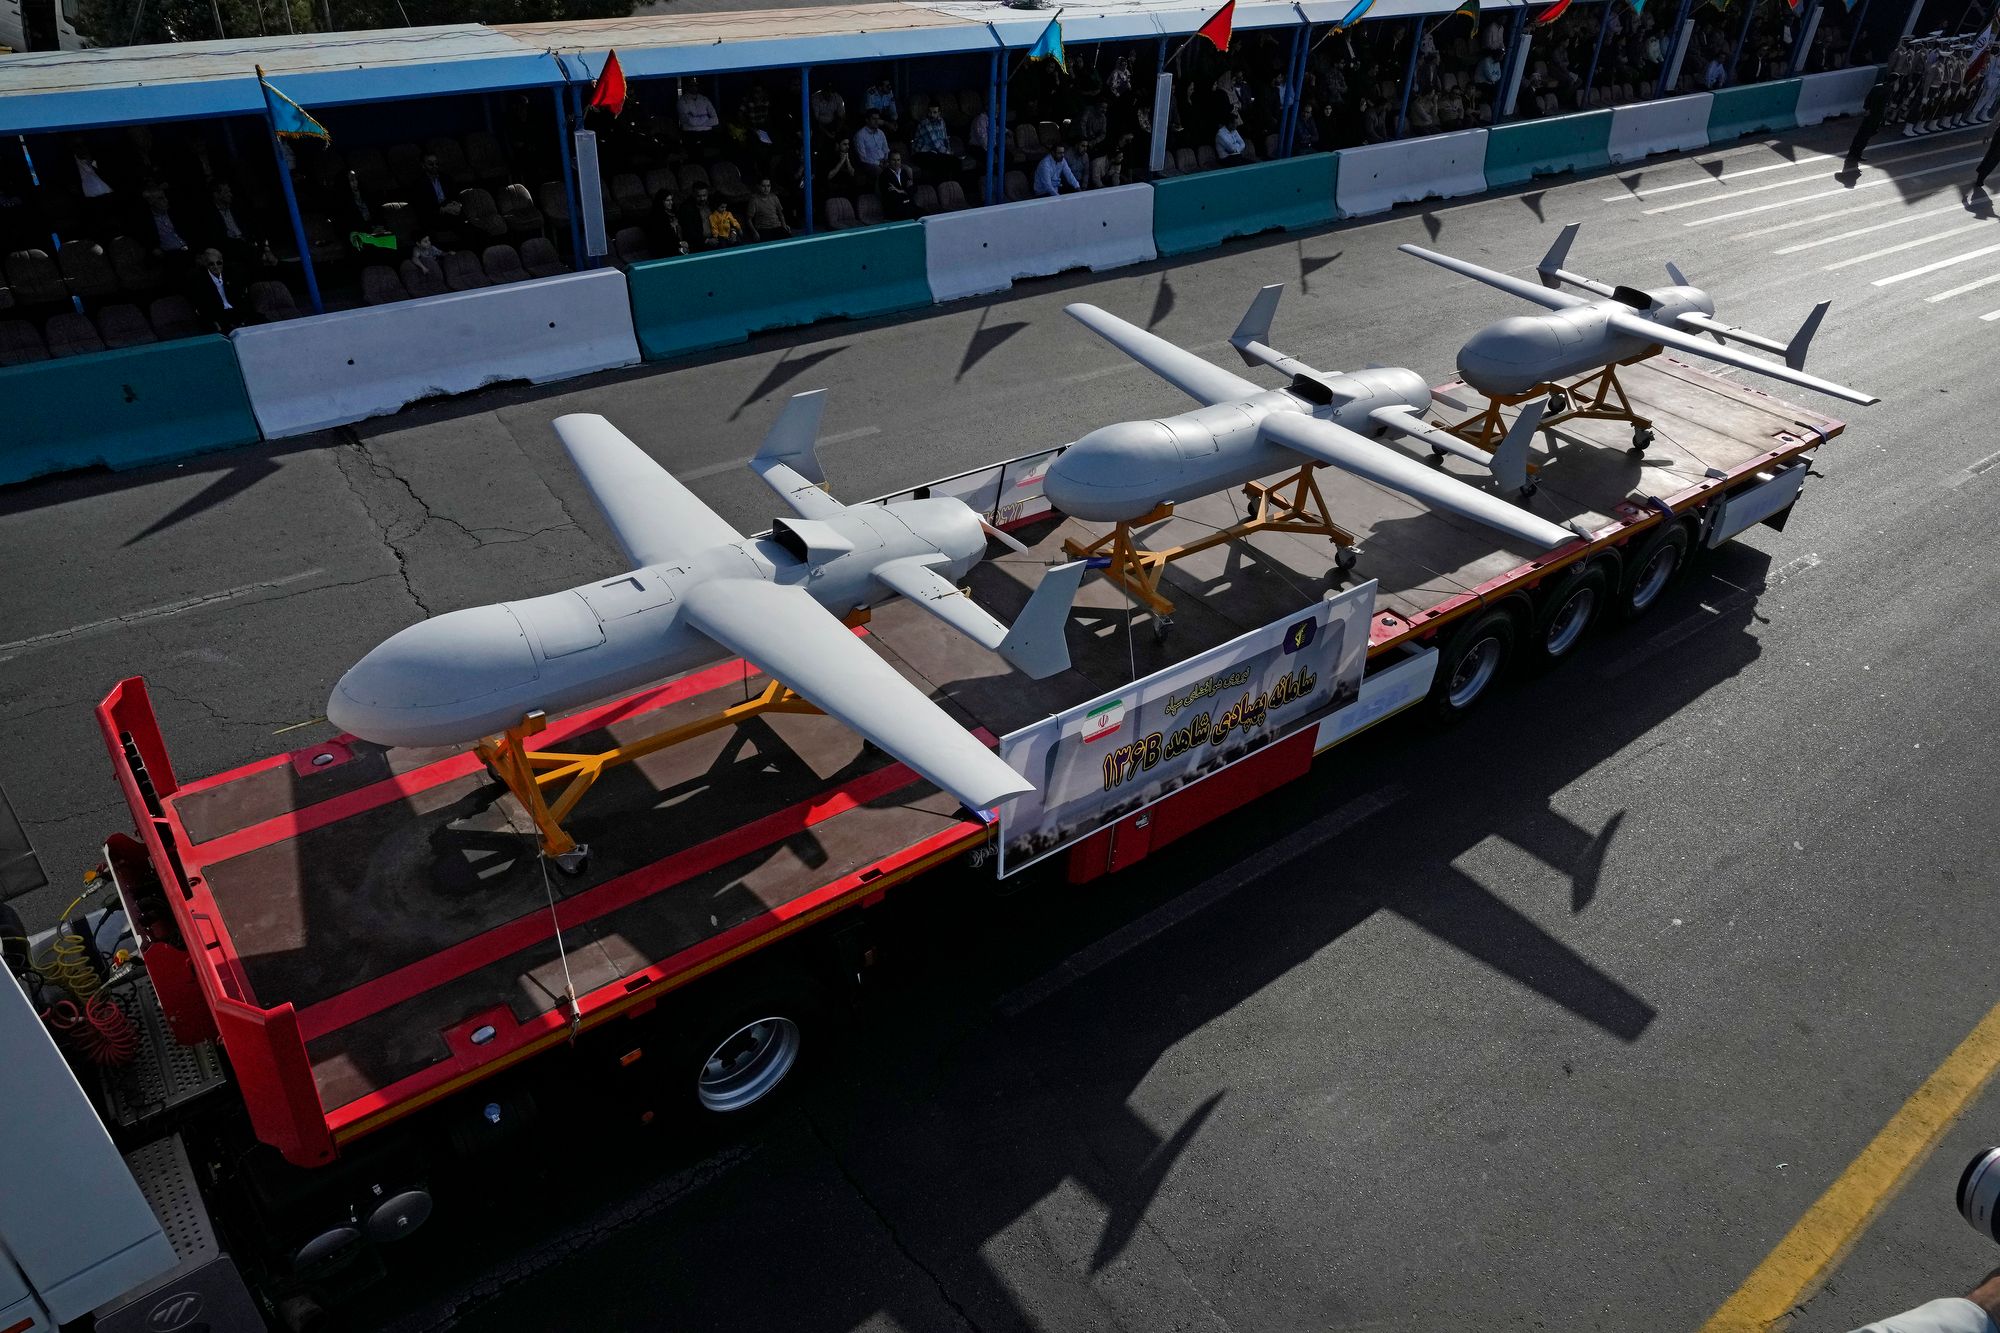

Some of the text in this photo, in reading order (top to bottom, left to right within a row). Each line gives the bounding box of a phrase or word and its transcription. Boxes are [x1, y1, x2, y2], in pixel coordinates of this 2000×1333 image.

[1268, 664, 1317, 710] سامانه
[1164, 712, 1211, 761] شاهد
[1210, 692, 1267, 746] پهپادی
